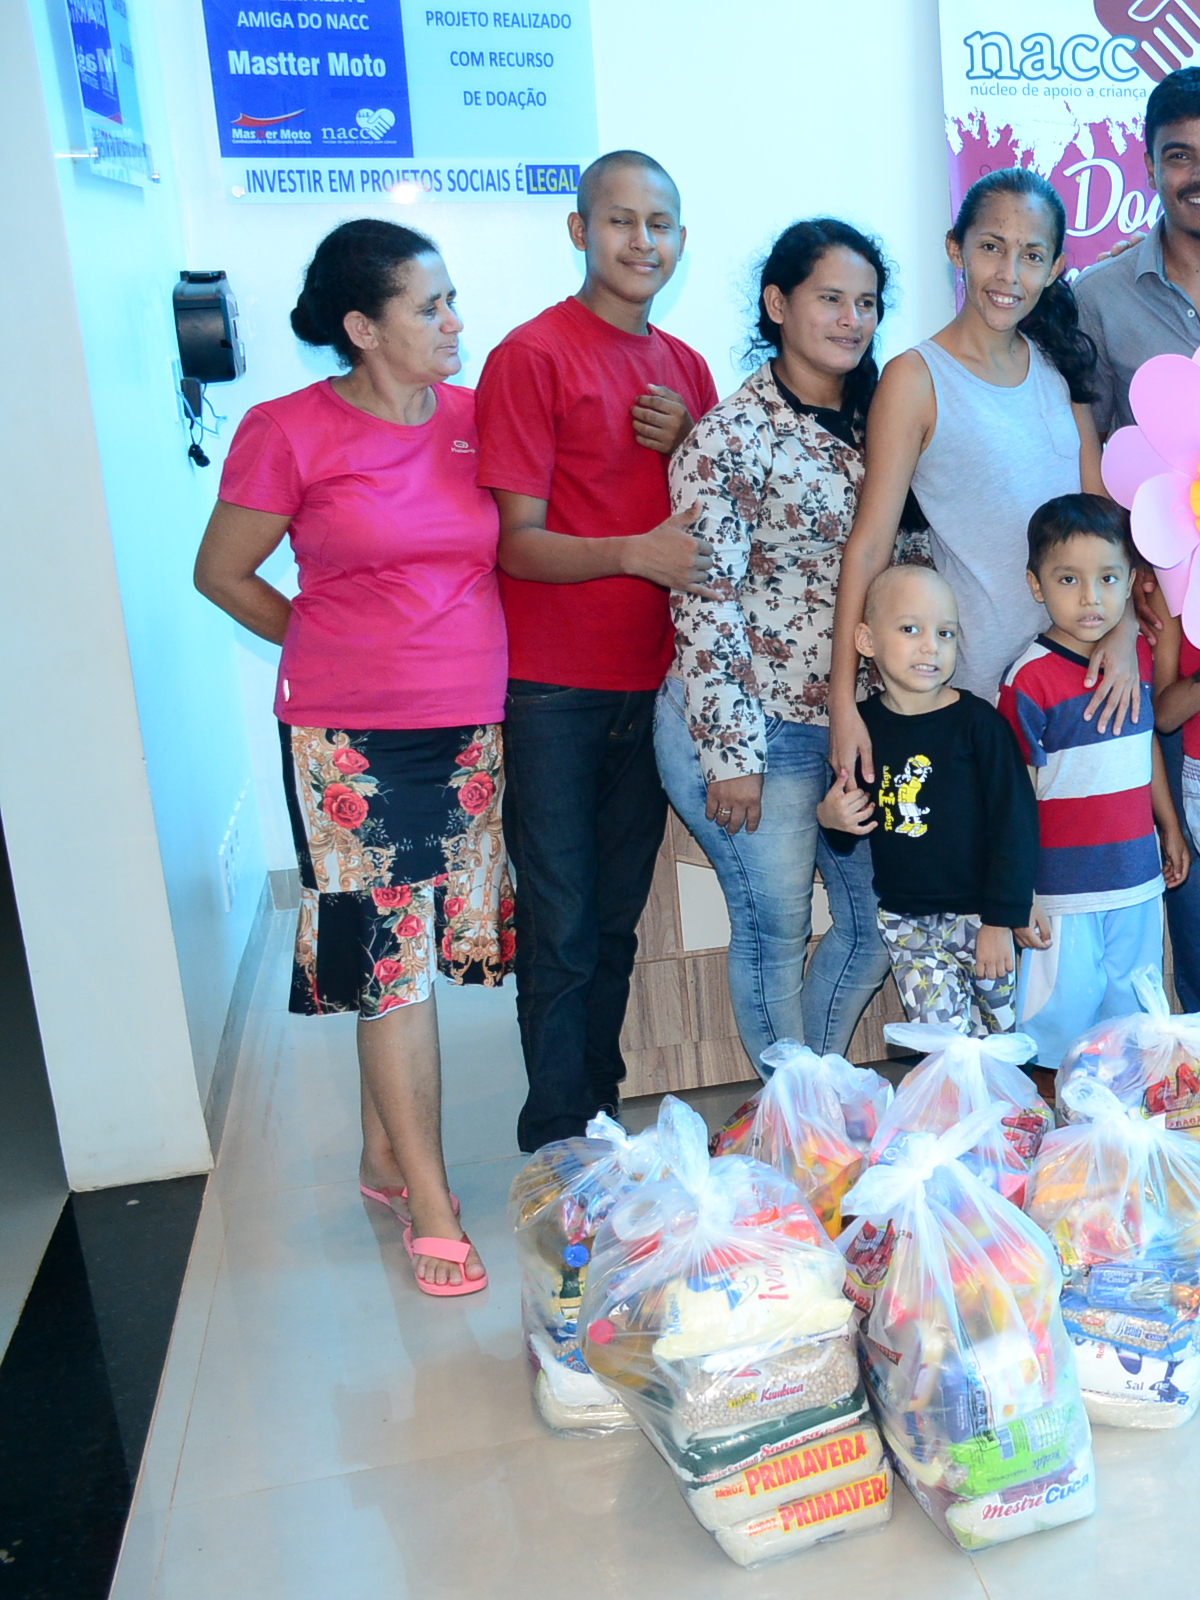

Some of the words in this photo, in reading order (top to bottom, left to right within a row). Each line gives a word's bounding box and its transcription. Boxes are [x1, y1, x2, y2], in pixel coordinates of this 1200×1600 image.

[237, 11, 295, 29] AMIGA
[298, 13, 322, 29] DO
[326, 14, 370, 30] NACC
[425, 10, 489, 27] PROJETO
[493, 12, 572, 29] REALIZADO
[228, 50, 320, 76] Mastter
[327, 52, 387, 77] Moto
[450, 51, 485, 67] COM
[489, 52, 554, 68] RECURSO
[964, 31, 1140, 82] nacc
[463, 90, 482, 106] DE
[486, 87, 547, 110] DOAÇÃO
[970, 82, 1017, 96] núcleo
[1022, 83, 1039, 96] de
[1043, 83, 1082, 100] apoio
[1086, 87, 1095, 97] a
[1099, 85, 1147, 101] criança
[280, 129, 312, 140] Moto
[321, 127, 371, 140] nacc
[246, 169, 324, 193] INVESTIR
[328, 169, 356, 193] EM
[447, 168, 510, 192] SOCIAIS
[515, 162, 524, 192] É
[529, 168, 579, 192] LEGAL
[1124, 1380, 1144, 1391] Sal
[714, 1482, 745, 1499] ARROZ
[743, 1432, 868, 1497] PRIMAVERA
[981, 1492, 1045, 1521] Mestre
[1045, 1472, 1090, 1506] Cuca
